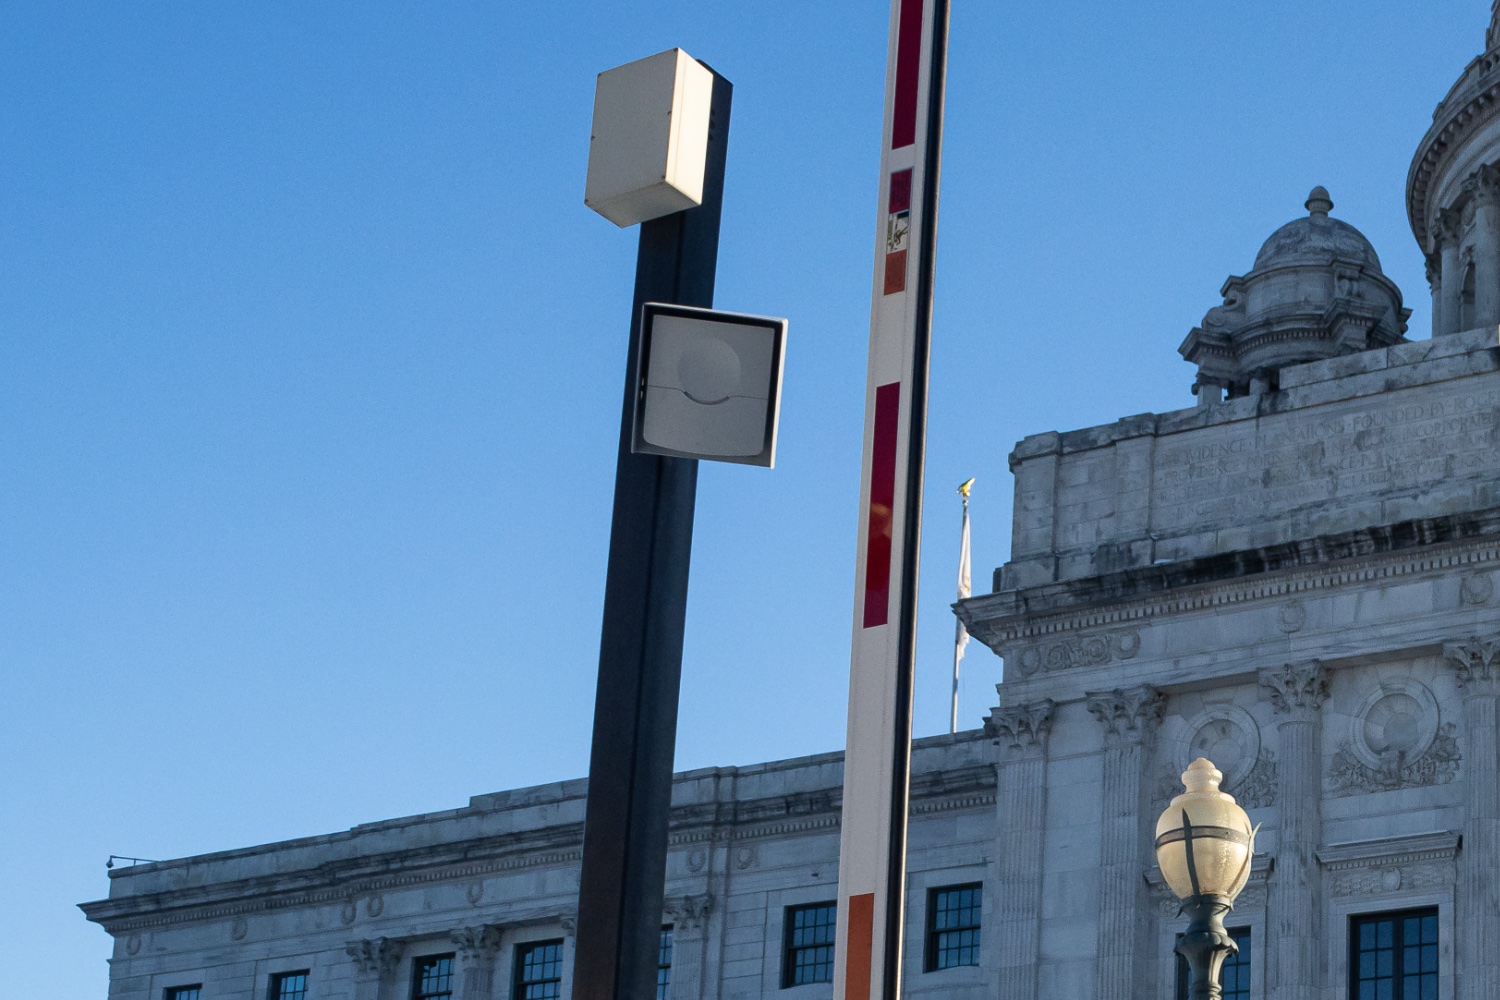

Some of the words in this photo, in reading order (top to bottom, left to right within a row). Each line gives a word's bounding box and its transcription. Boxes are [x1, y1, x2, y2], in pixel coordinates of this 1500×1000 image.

[1162, 438, 1243, 465] PROVIDENCE
[1254, 419, 1344, 448] PLANTATIONS
[1352, 405, 1424, 430] FOUNDED
[1430, 401, 1444, 415] BY
